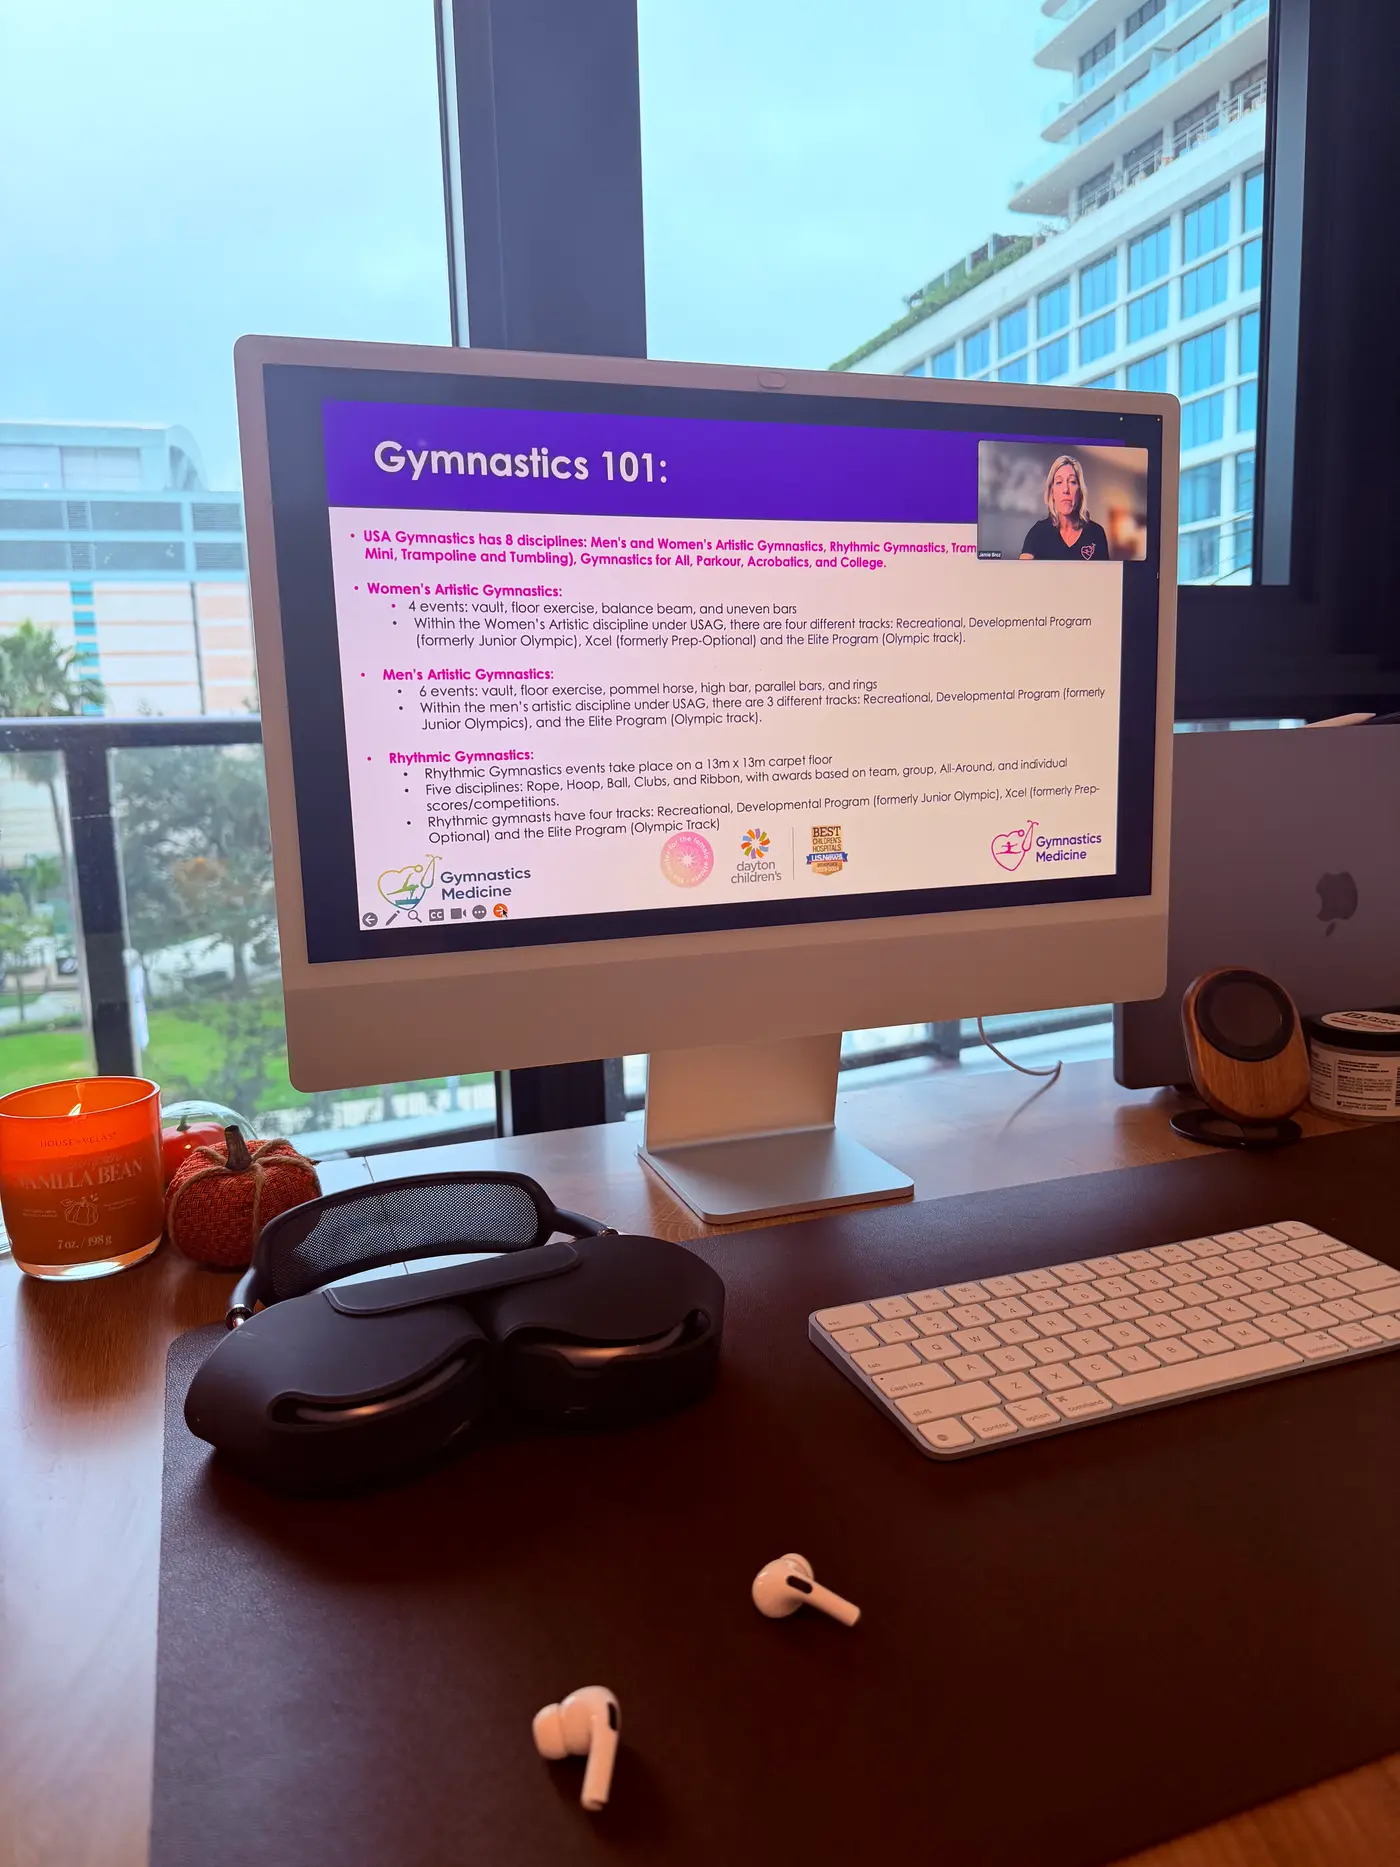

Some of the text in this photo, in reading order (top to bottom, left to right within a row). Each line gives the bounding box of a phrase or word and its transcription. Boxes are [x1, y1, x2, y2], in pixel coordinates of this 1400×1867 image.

[374, 440, 667, 483] Gymnastics 101:
[363, 529, 976, 556] USA Gymnastics has 8 disciplines: Men's and Women's Artistic Gymnastics, Rhythmic Gymnastics, Tram
[364, 547, 887, 570] Mini, Trampoline and Tumbling), Gymnastics for All, Parkour, Acrobatics, and College.
[367, 582, 563, 599] Women's Artistic Gymnastics:
[408, 600, 797, 615] 4 events: vault, floor exercise, balance beam, and uneven bars
[414, 616, 1092, 632] Within the Women's Artistic discipline under USAG, there are four different tracks: Recreational, Developmental Program
[382, 668, 554, 682] Men's Artistic Gymnastics:
[419, 679, 878, 697] 6 events: vault, floor exercise, pommel horse, high bar, parallel bars, and rings
[421, 711, 762, 731] Junior Olympics), and the Elite Program (Olympic track).
[388, 749, 534, 766] Rhythmic Gymnastics:
[424, 754, 833, 780] Rhythmic Gymnastics events take place on a 13m x 13m carpet floor
[425, 758, 1068, 795] Five disciplines: Rope, Hoop, Ball, Clubs, and Ribbon, with awards based on team, group, All-Around, and individual
[426, 796, 560, 811] scores/competitions.
[428, 818, 720, 845] Optional) and the Elite Program (Olympic Track)
[812, 826, 841, 837] BEST
[812, 844, 841, 852] HOSPITALS
[1036, 833, 1102, 849] Gymnastics
[1036, 849, 1087, 862] Medicine
[736, 860, 776, 872] dayton
[440, 868, 532, 886] Gymnastics
[730, 871, 782, 884] children's
[442, 887, 512, 900] Medicine
[40, 1139, 74, 1148] HOUSE
[98, 1158, 143, 1184] BEAN
[58, 1240, 62, 1250] 7
[64, 1240, 79, 1248] oz.
[88, 1234, 104, 1247] 198
[106, 1235, 112, 1246] g
[1010, 1326, 1020, 1334] E
[932, 1343, 942, 1351] Q
[969, 1335, 982, 1344] W
[1068, 1399, 1104, 1412] command
[1026, 1412, 1052, 1422] option
[982, 1422, 1010, 1433] control
